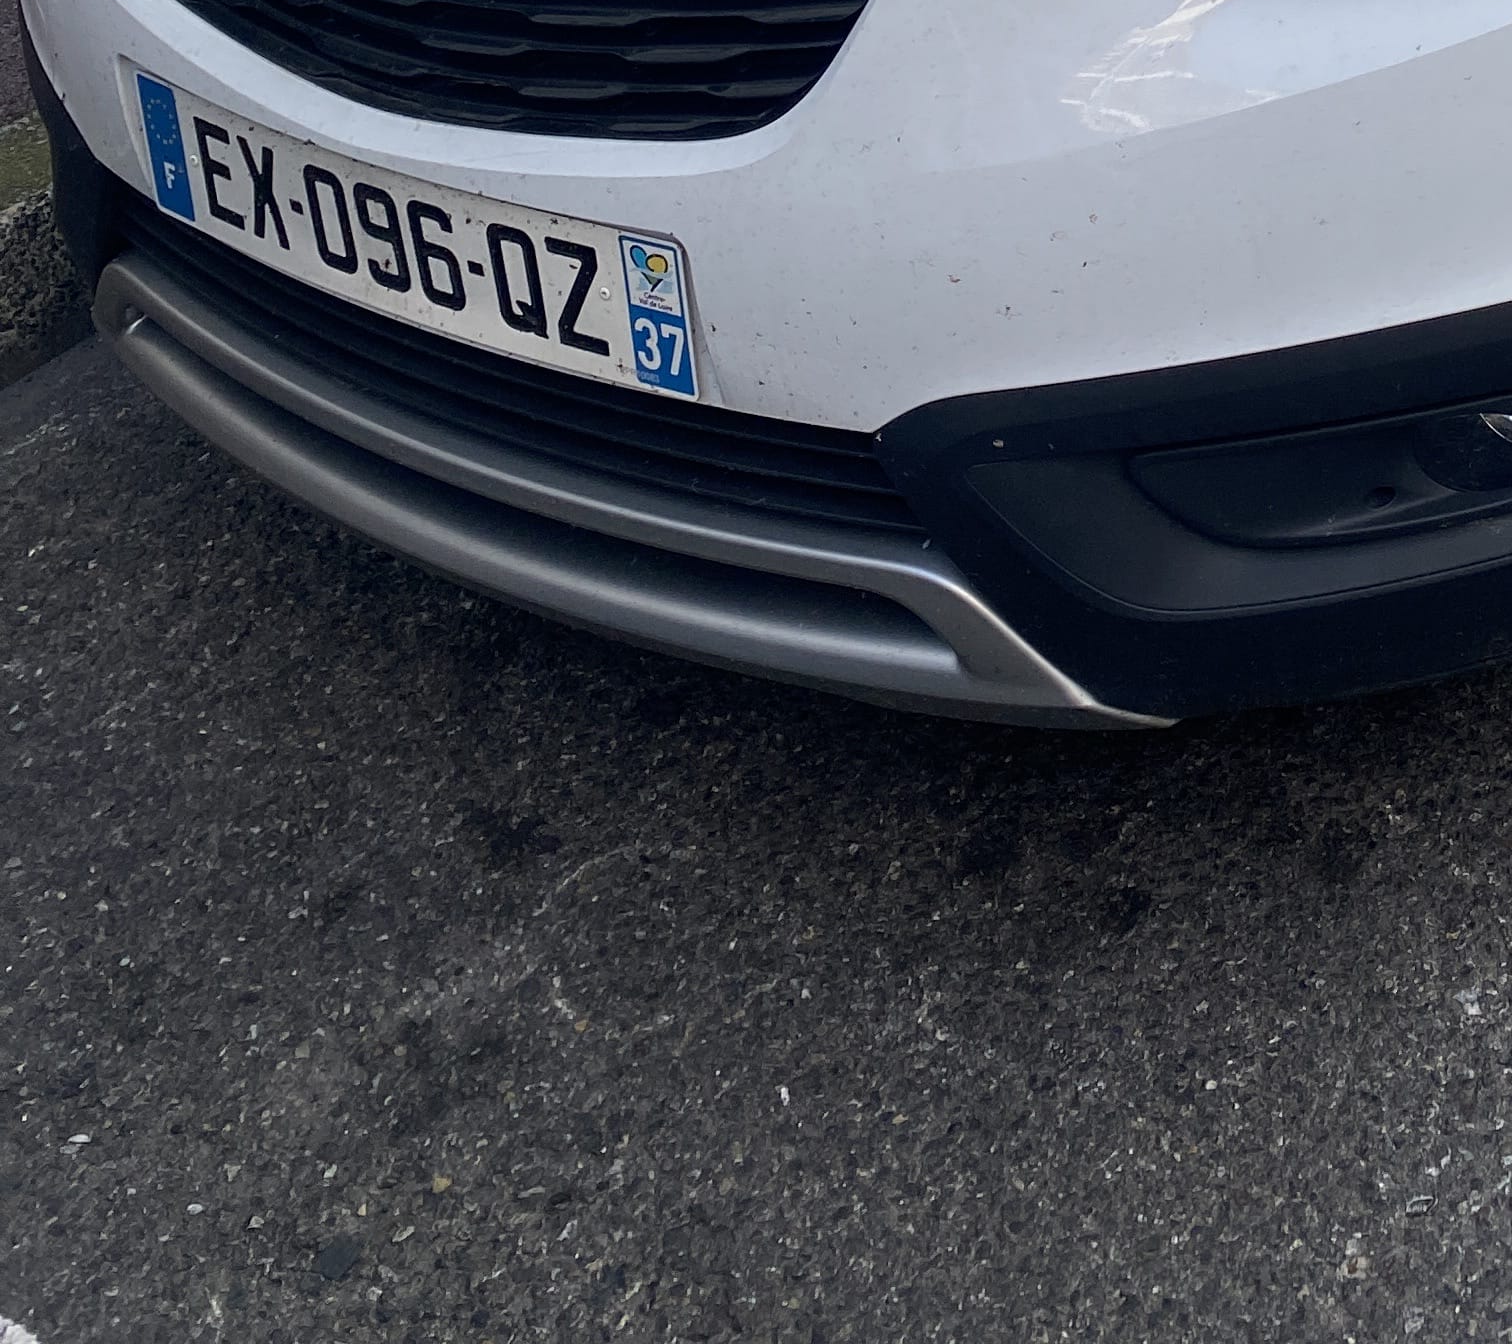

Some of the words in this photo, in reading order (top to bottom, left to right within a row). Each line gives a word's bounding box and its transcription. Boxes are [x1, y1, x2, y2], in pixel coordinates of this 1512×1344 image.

[163, 161, 177, 190] F
[192, 115, 611, 358] EX-096-QZ
[634, 317, 685, 376] 37
